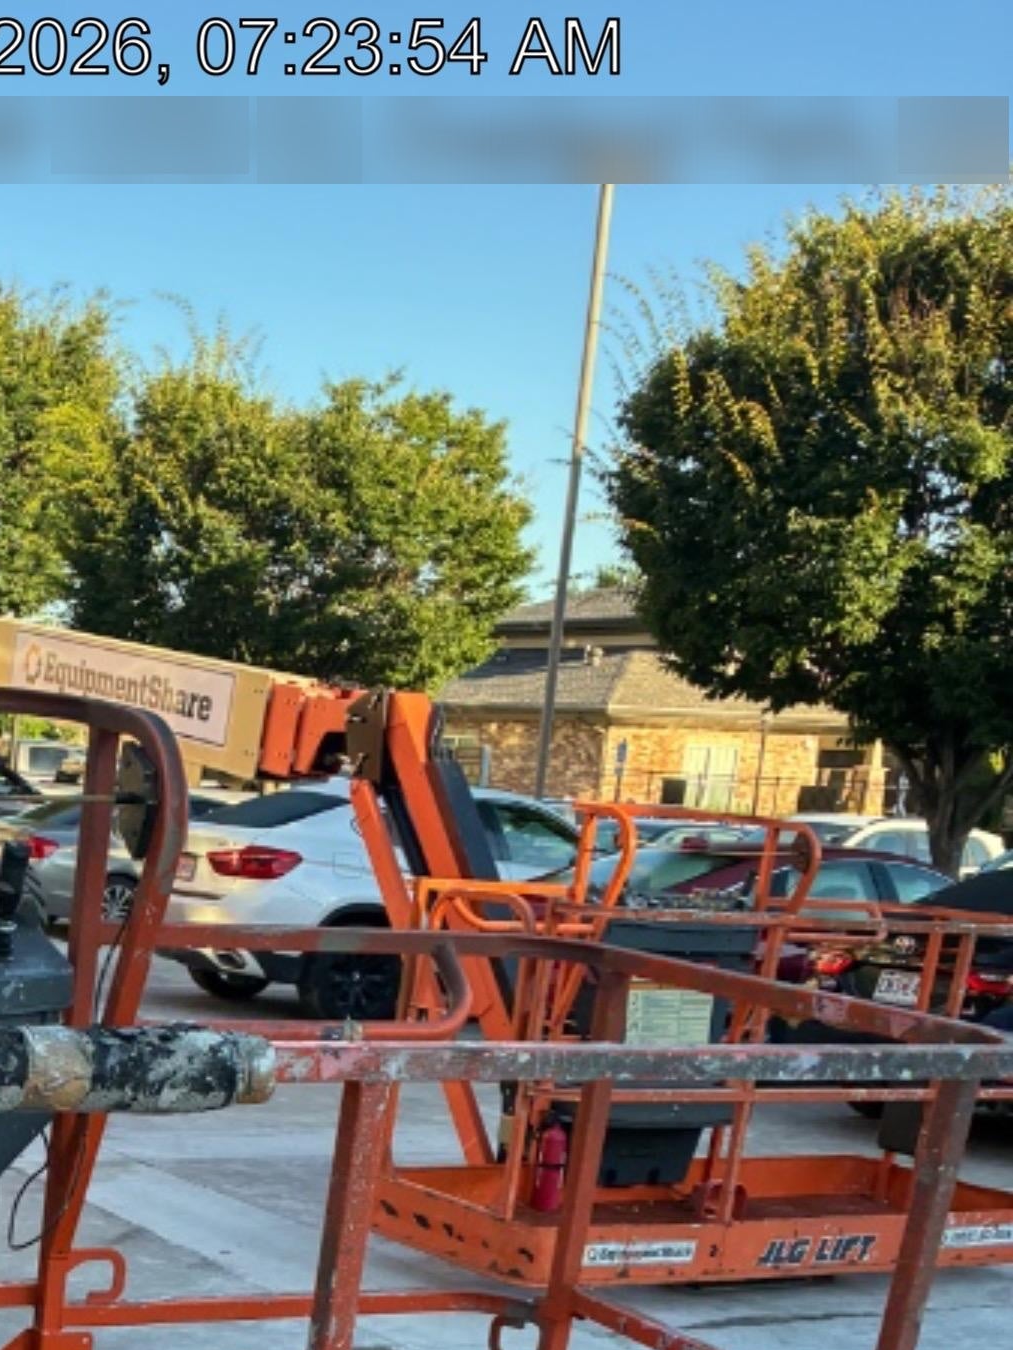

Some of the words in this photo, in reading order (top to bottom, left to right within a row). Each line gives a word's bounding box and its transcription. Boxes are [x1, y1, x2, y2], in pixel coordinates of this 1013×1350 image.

[43, 652, 213, 721] EquipmentShare
[756, 1238, 811, 1266] JLG
[814, 1234, 877, 1262] LIFT
